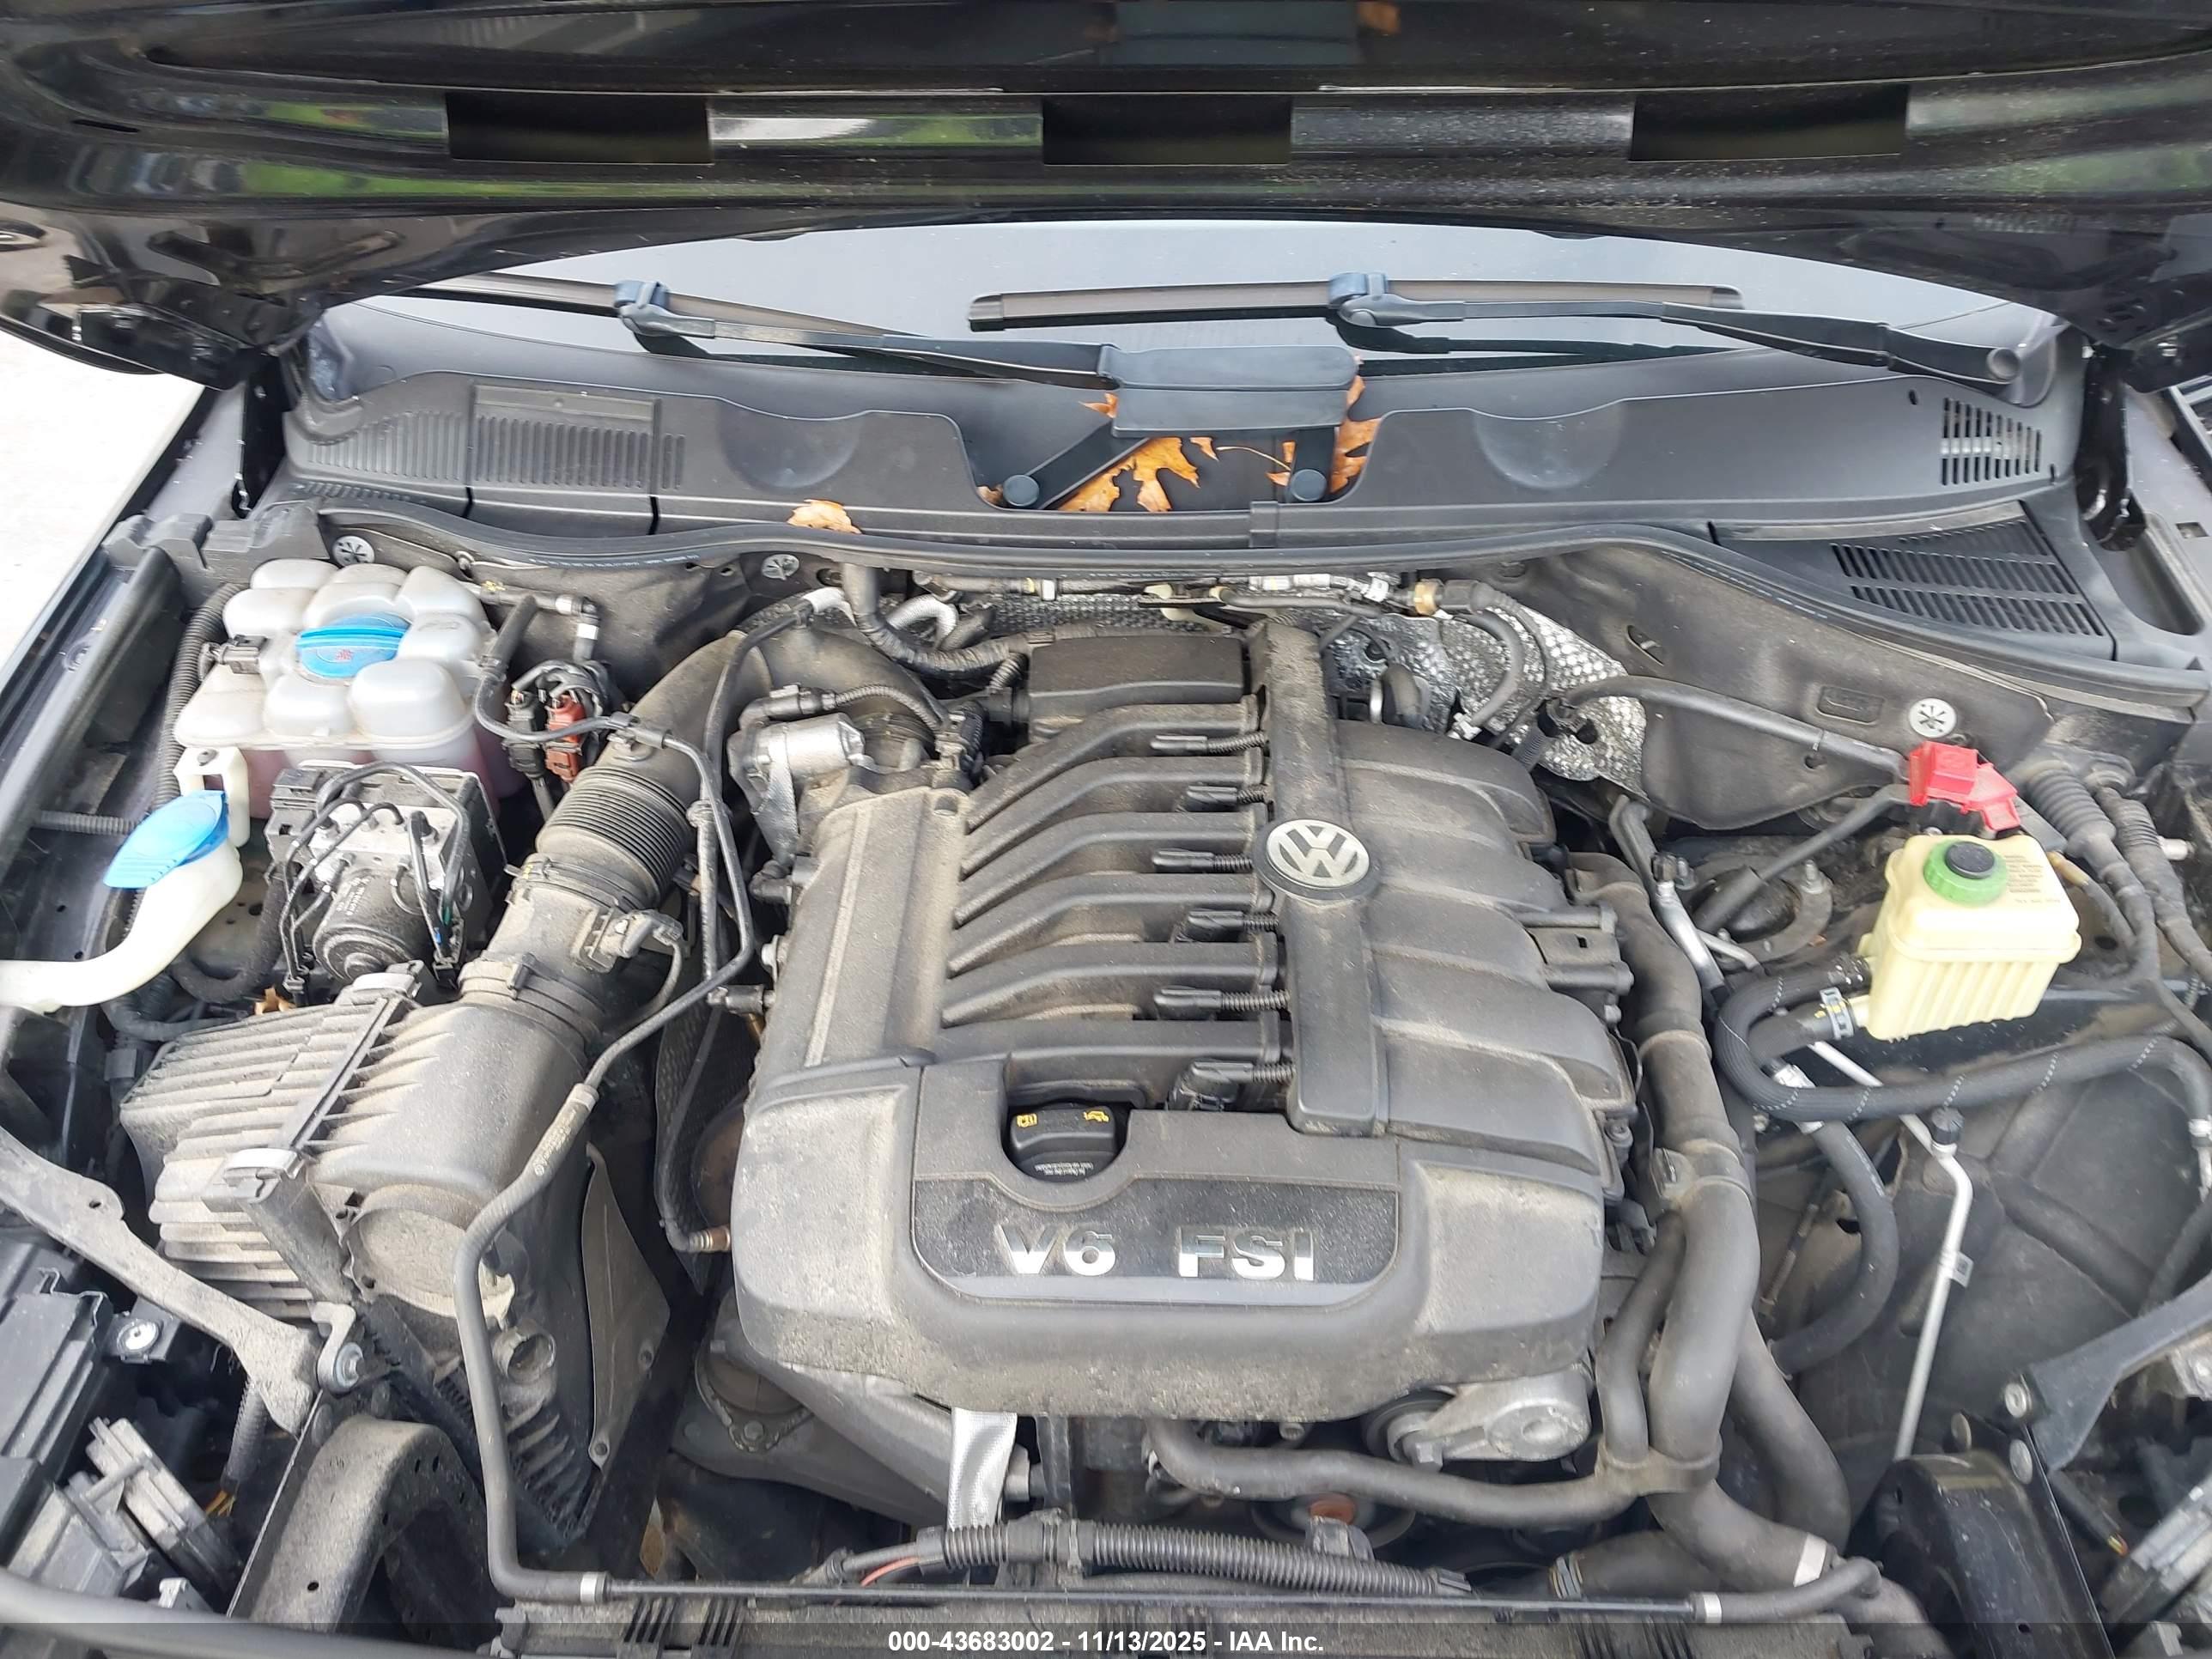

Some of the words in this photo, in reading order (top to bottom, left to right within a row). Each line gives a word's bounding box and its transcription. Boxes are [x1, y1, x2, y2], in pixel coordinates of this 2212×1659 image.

[1267, 820, 1369, 888] VW
[996, 1224, 1116, 1277] V6
[1177, 1225, 1315, 1281] FSI
